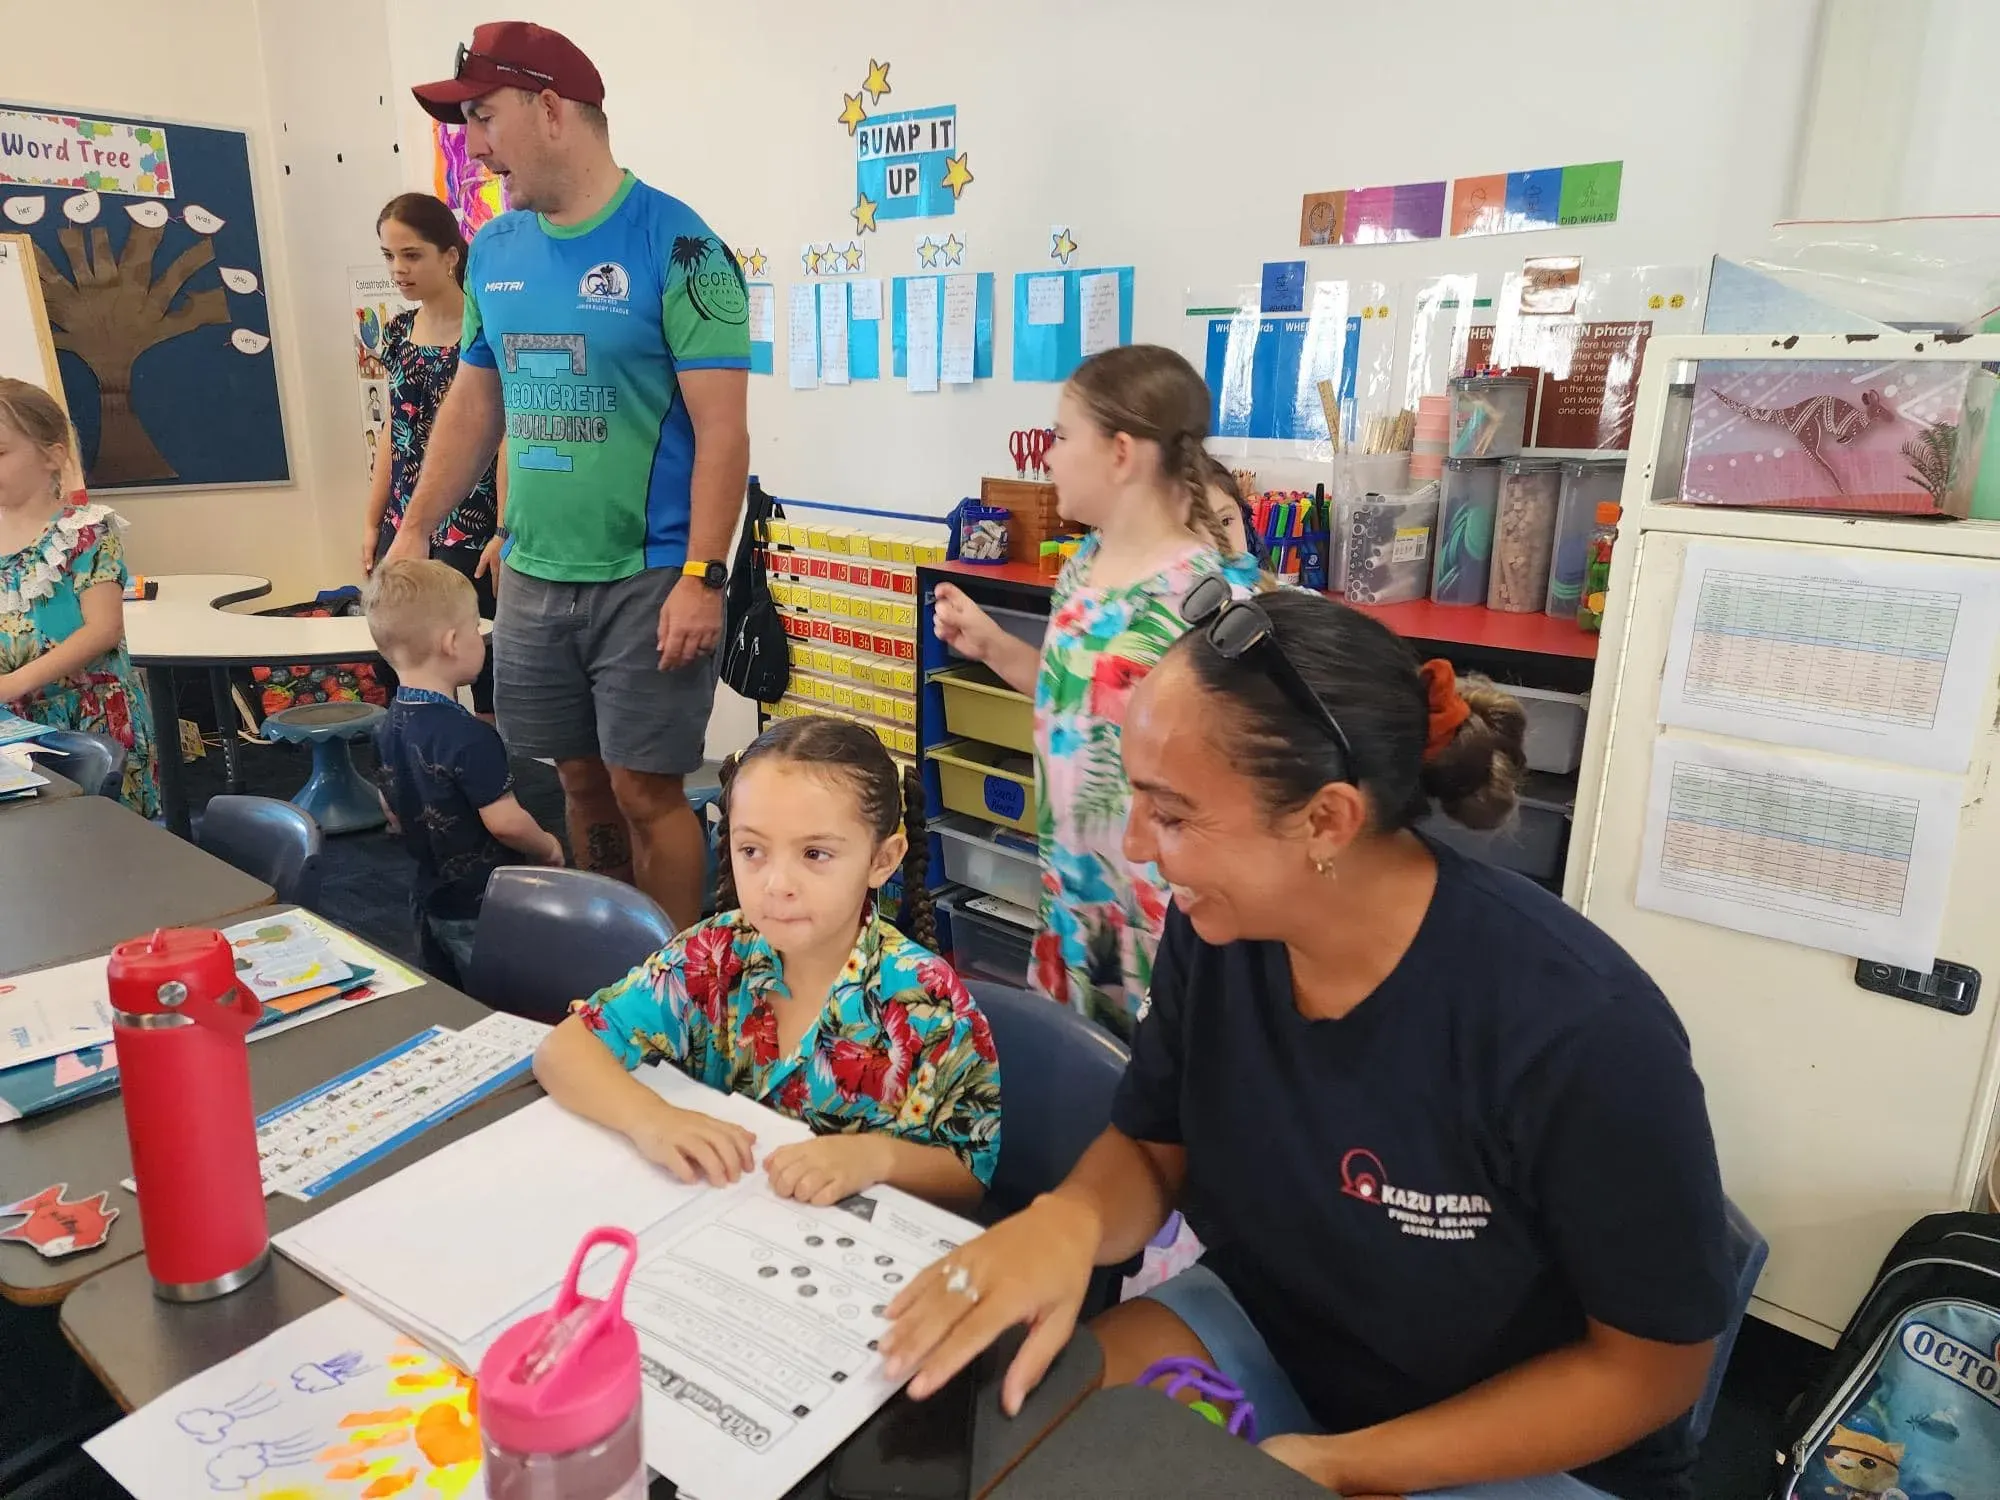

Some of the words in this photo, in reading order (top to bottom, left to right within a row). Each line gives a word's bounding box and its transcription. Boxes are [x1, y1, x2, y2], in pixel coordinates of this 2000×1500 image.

[860, 124, 921, 157] BUMP
[931, 119, 953, 150] IT
[1, 132, 69, 162] Word
[76, 139, 131, 168] Tree
[889, 168, 917, 195] UP
[195, 214, 212, 224] was
[1561, 216, 1579, 225] DID
[1580, 212, 1614, 224] WHAT?
[233, 273, 248, 285] you
[484, 281, 525, 293] MATAI
[1470, 326, 1496, 340] HEN
[1594, 323, 1650, 339] phrases
[240, 337, 257, 349] very
[1601, 340, 1628, 349] lunch
[1558, 384, 1568, 393] in
[1569, 384, 1585, 393] the
[1563, 396, 1576, 404] on
[1578, 407, 1600, 415] cold
[512, 413, 608, 443] BUILDING
[777, 558, 789, 572] 12
[798, 560, 808, 574] 13
[817, 563, 827, 577] 14
[837, 565, 848, 579] 15
[859, 573, 867, 585] 16
[880, 573, 890, 587] 17
[902, 578, 912, 593] 18
[776, 587, 790, 600] 22
[835, 598, 848, 613] 25
[879, 607, 890, 621] 27
[898, 609, 911, 624] 28
[797, 621, 809, 635] 33
[815, 624, 829, 639] 34
[837, 630, 850, 644] 35
[859, 635, 870, 649] 36
[880, 639, 891, 654] 37
[900, 643, 912, 657] 38
[900, 672, 912, 688] 48
[800, 680, 812, 694] 53
[840, 691, 851, 704] 55
[860, 697, 871, 710] 56
[881, 700, 892, 713] 57
[902, 705, 913, 720] 58
[903, 736, 914, 751] 68
[1381, 1184, 1432, 1213] KAZU
[1388, 1208, 1436, 1227] FRIDAY
[1438, 1217, 1488, 1228] ISLAND
[1401, 1224, 1475, 1240] AUSTRALIA
[1913, 1330, 2000, 1400] OCTO
